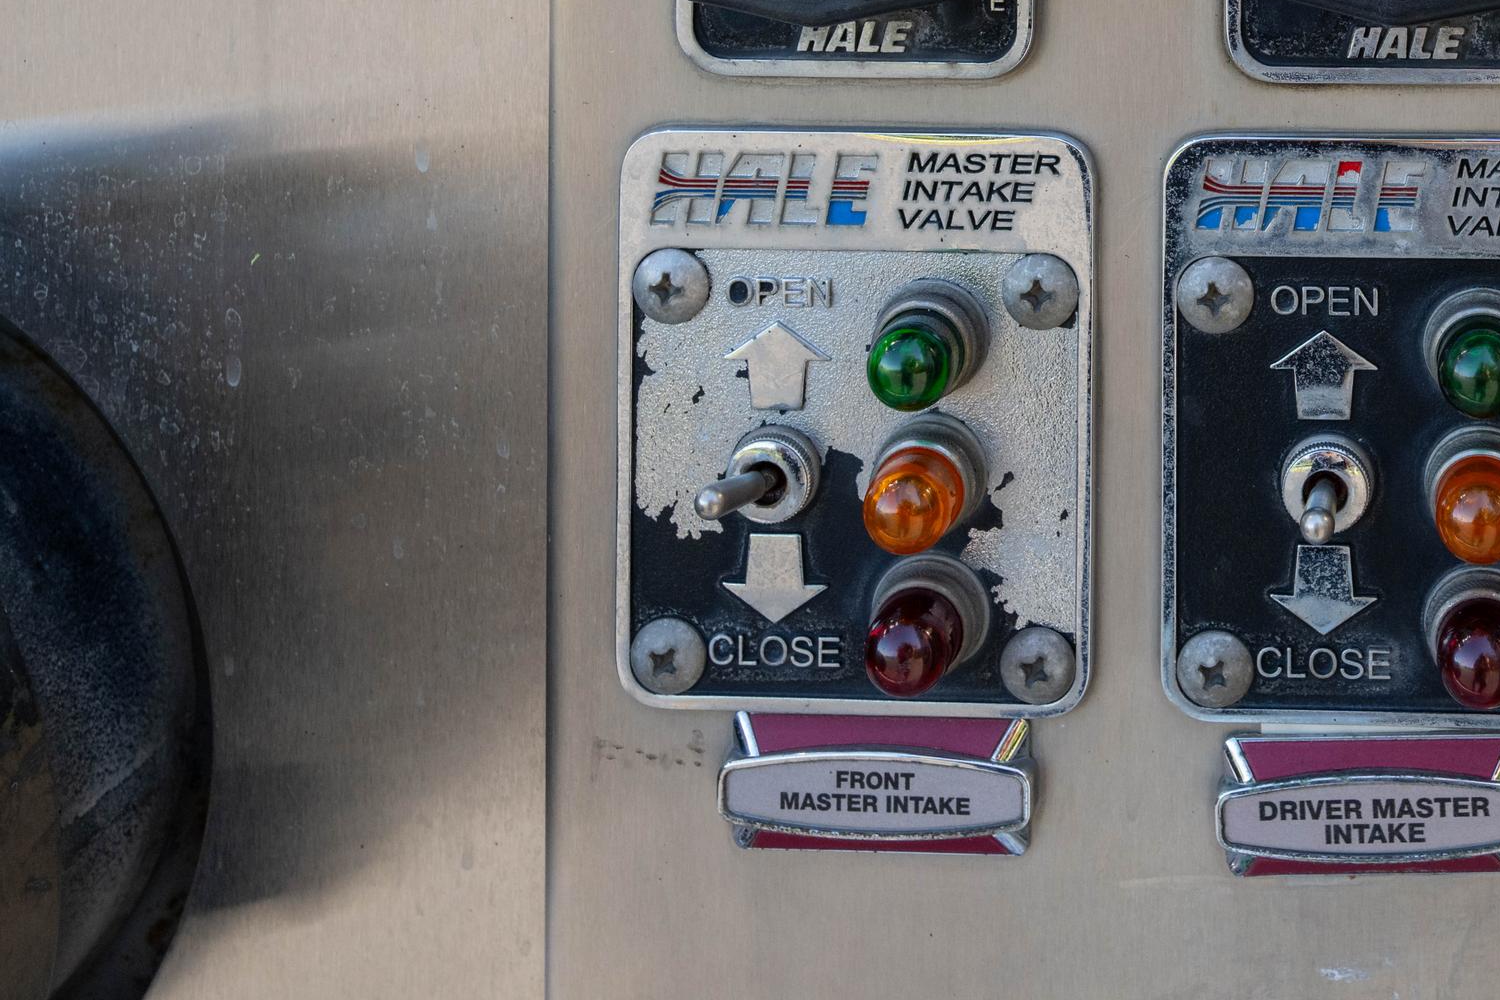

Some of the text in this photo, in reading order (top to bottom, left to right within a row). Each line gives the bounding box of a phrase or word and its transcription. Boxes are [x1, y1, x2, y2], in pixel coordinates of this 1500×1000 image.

[797, 21, 912, 53] HALE
[1347, 26, 1464, 60] HALE
[907, 152, 1061, 175] MASTER
[651, 152, 879, 226] HALE
[902, 180, 1035, 203] INTAKE
[1195, 159, 1427, 233] HALE
[897, 208, 1016, 231] VALVE
[728, 276, 834, 308] OPEN
[1270, 284, 1379, 317] OPEN
[708, 634, 841, 668] CLOSE
[1256, 646, 1392, 681] CLOSE
[835, 771, 915, 791] FRONT
[779, 792, 971, 816] MASTER INTAKE
[1258, 797, 1490, 822] DRIVER MASTER
[1324, 823, 1426, 845] INTAKE
